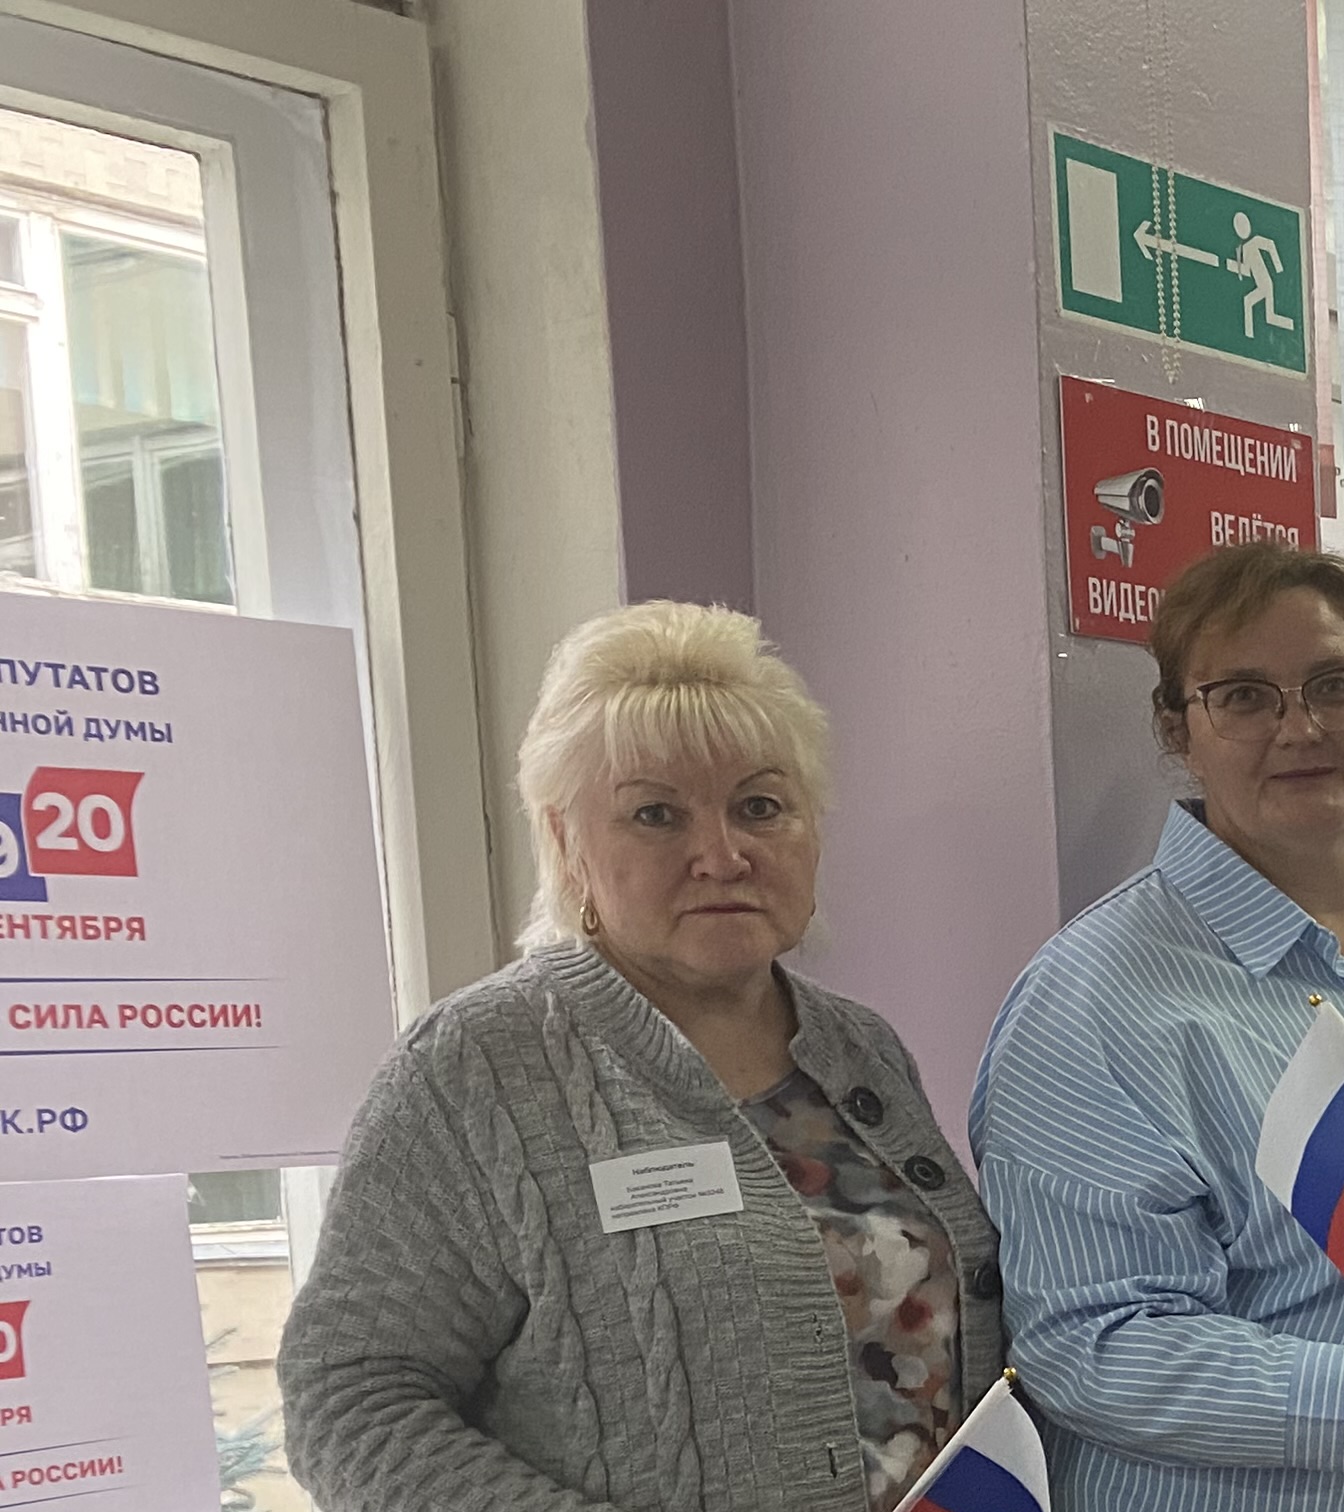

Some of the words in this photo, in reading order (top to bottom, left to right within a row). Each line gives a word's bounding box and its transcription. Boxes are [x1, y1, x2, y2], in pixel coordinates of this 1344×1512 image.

[1146, 414, 1160, 452] В
[1165, 419, 1298, 483] ПОМЕЩЕНИИ
[1088, 576, 1166, 624] ВИДЕО
[83, 717, 174, 743] ДУМЫ
[31, 791, 125, 853] 20
[8, 1003, 110, 1030] СИЛА
[117, 1003, 263, 1029] РОССИИ!
[12, 1456, 123, 1488] РОССИИ!
